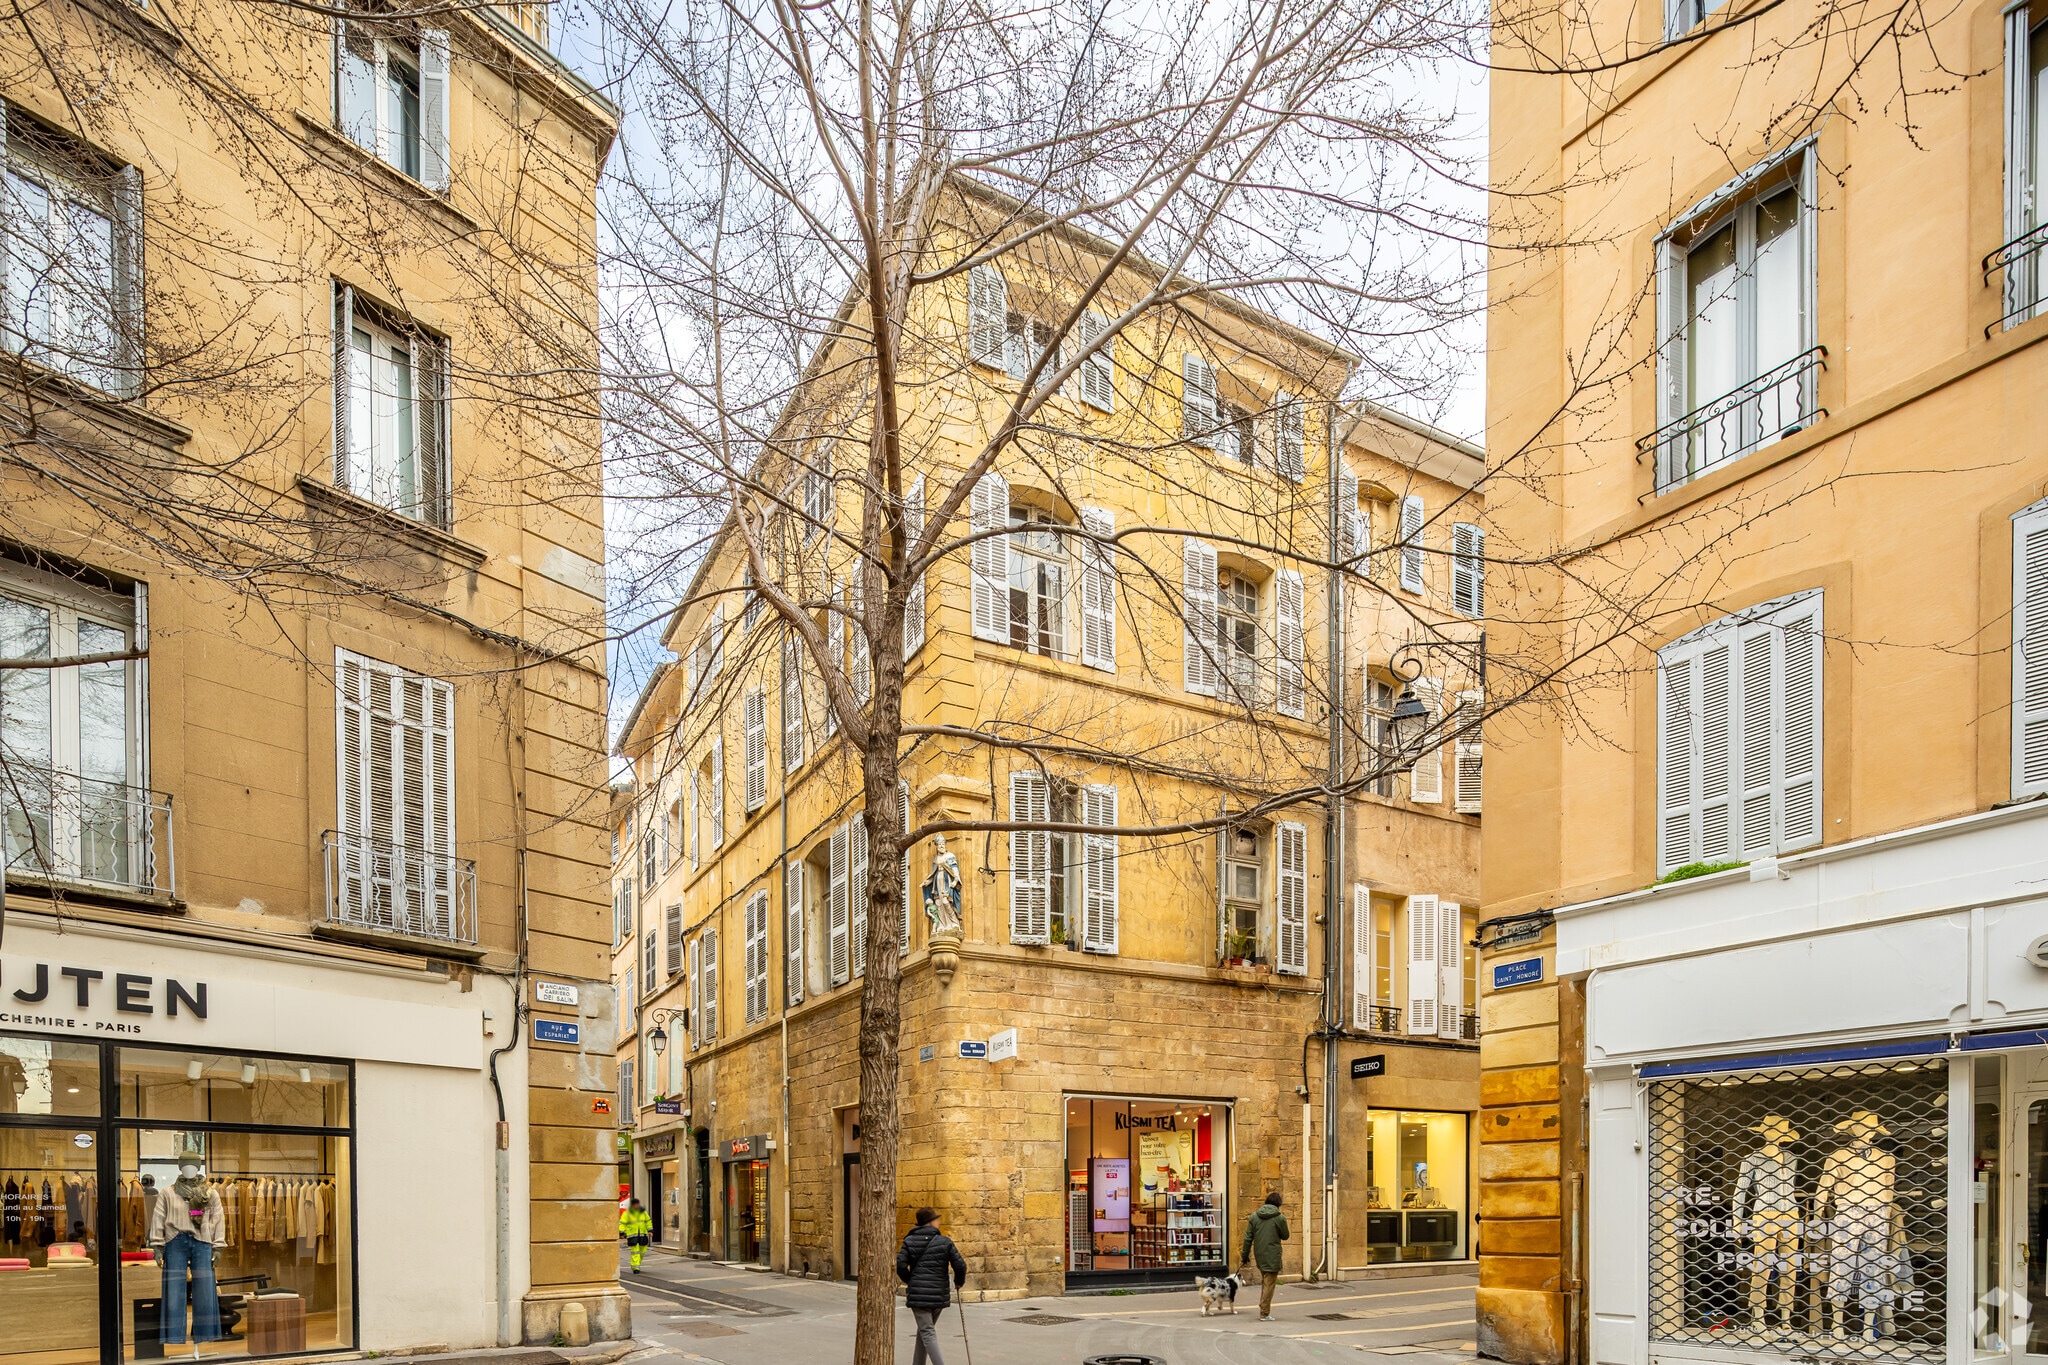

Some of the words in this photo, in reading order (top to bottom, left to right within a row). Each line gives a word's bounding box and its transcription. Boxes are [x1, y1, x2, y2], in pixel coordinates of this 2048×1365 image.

[1508, 964, 1527, 973] PLACE
[1496, 975, 1512, 984] SAINT
[1516, 970, 1539, 980] HONORÉ
[0, 958, 208, 1019] JTEN
[544, 989, 570, 997] CARRIERO
[0, 1013, 75, 1028] CHEMIRE
[96, 1021, 142, 1034] PARIS
[551, 1024, 563, 1032] RUE
[1354, 1061, 1380, 1073] SEIKO
[1115, 1112, 1152, 1130] KUSMI
[1155, 1115, 1177, 1132] TEA
